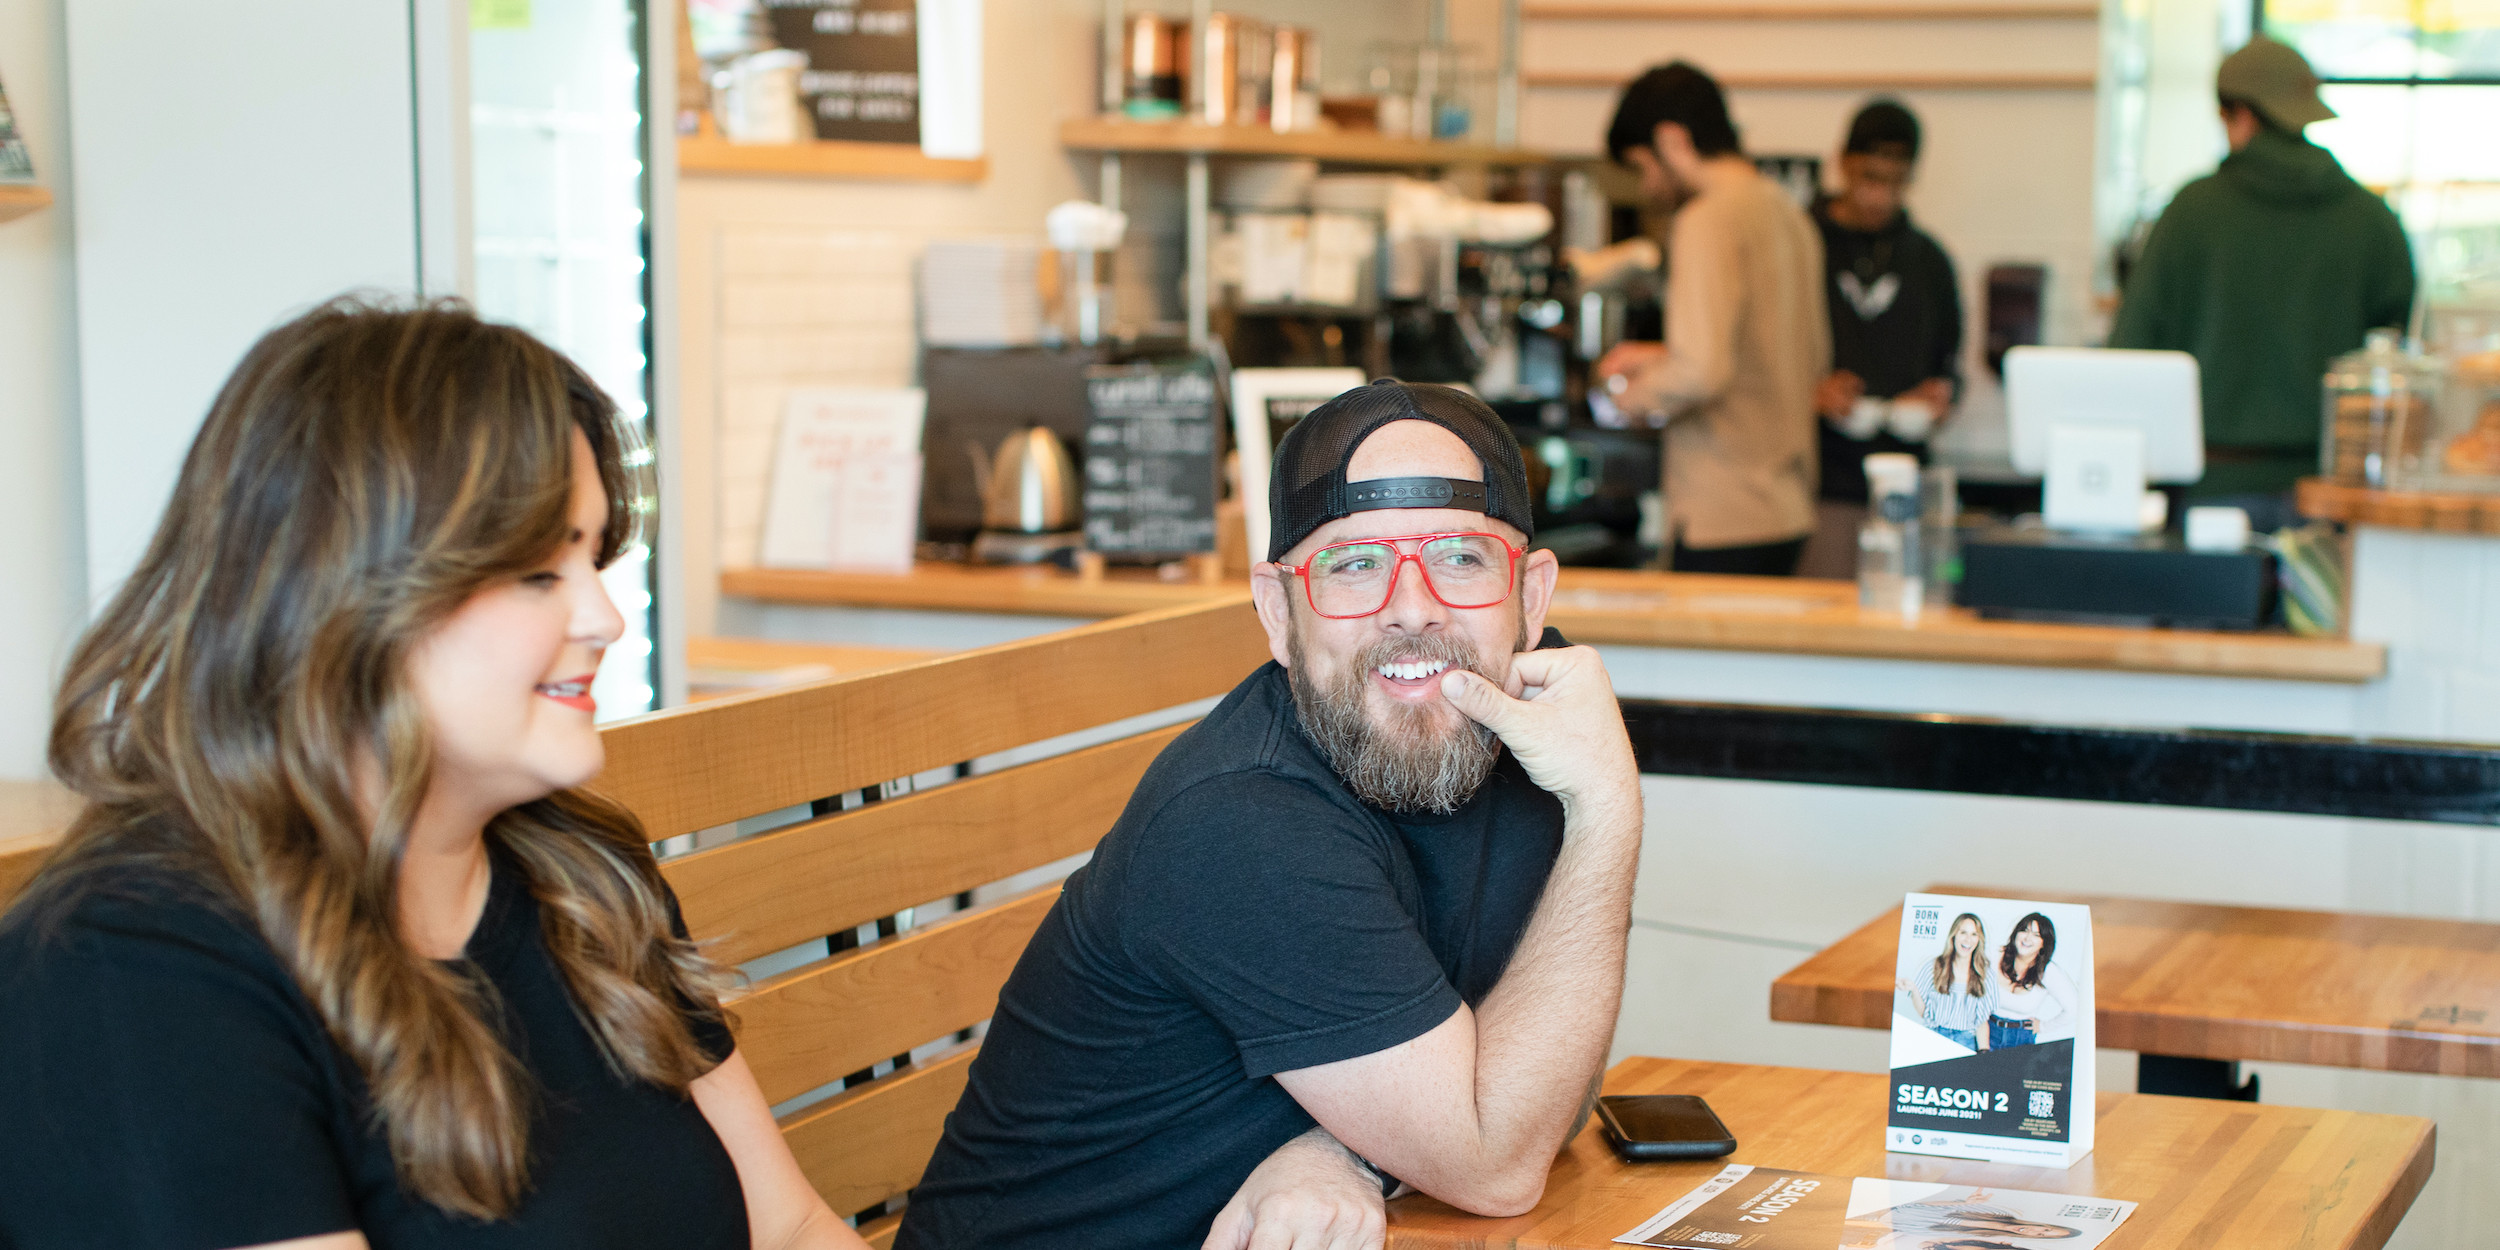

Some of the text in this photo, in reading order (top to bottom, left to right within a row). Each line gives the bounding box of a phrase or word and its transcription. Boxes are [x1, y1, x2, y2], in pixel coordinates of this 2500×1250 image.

[1915, 909, 1939, 920] BORN
[1913, 924, 1937, 935] BEND
[1897, 1083, 2009, 1112] SEASON 2
[1896, 1104, 1938, 1116] LAUNCHES
[1938, 1108, 1959, 1118] JUNE
[1749, 1178, 1821, 1216] SEASON
[1738, 1214, 1770, 1223] 2
